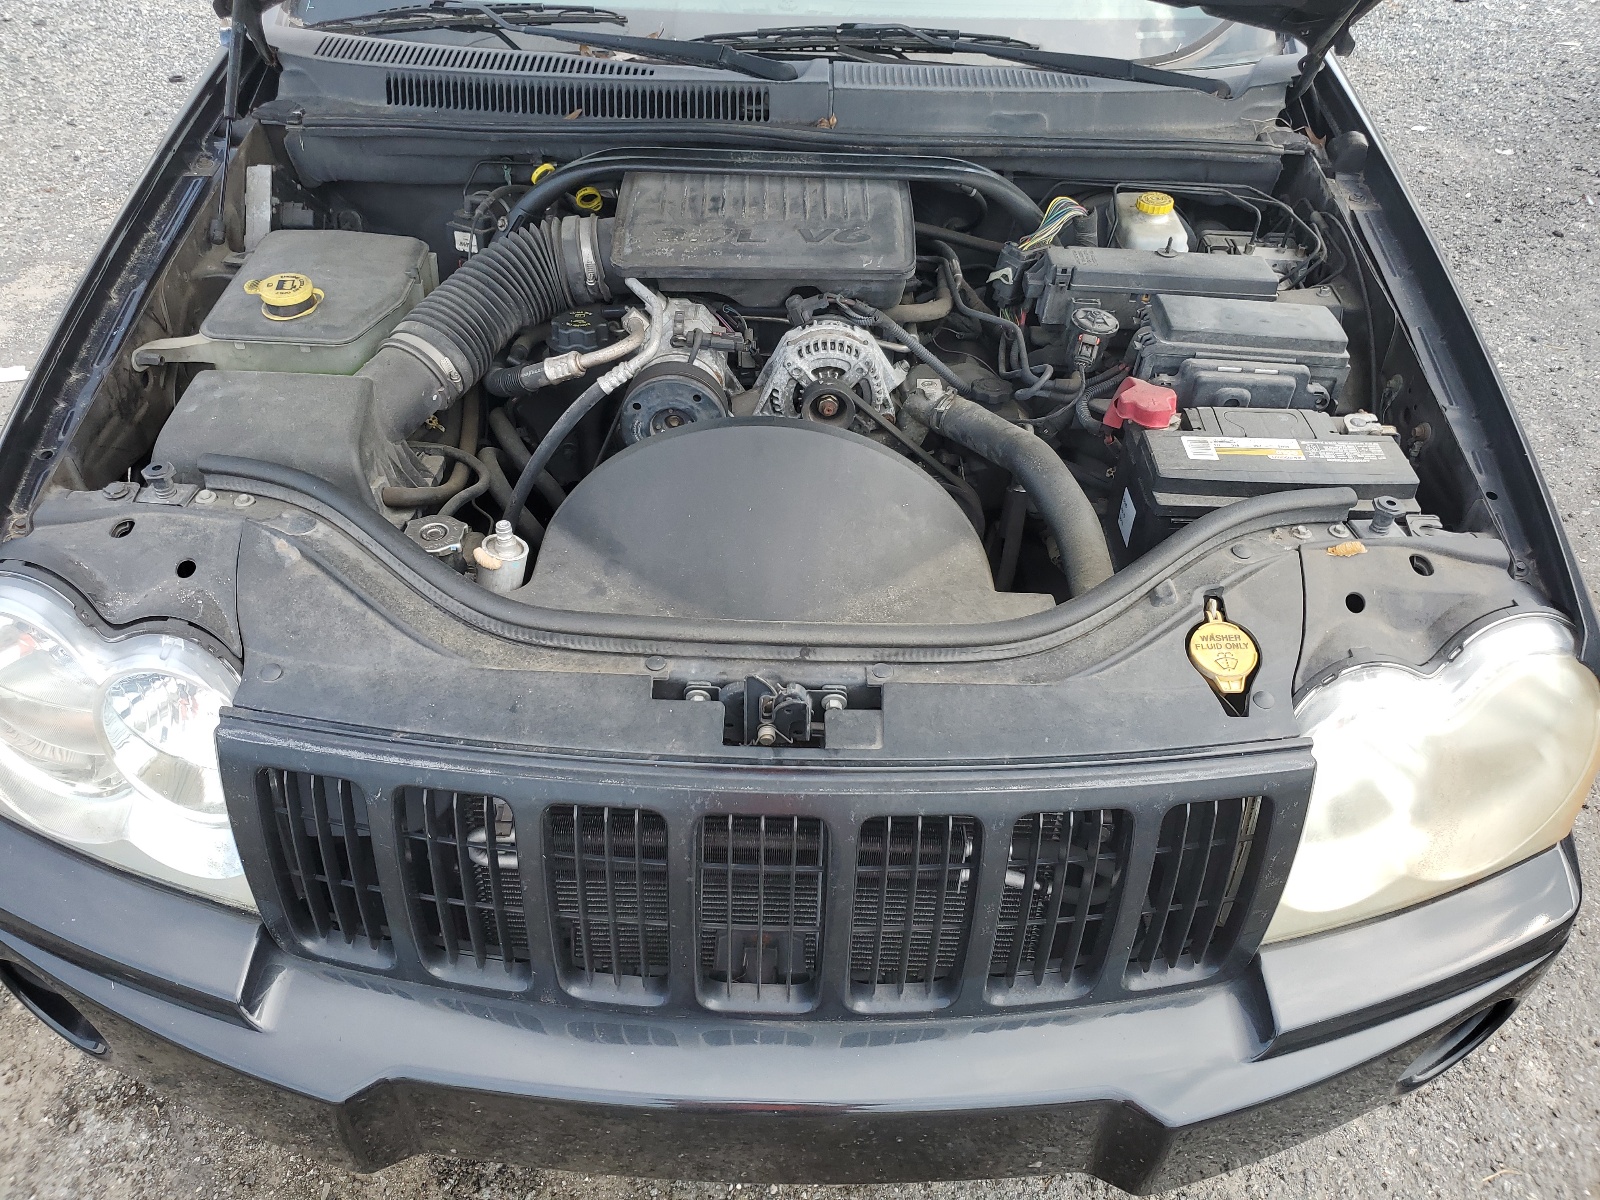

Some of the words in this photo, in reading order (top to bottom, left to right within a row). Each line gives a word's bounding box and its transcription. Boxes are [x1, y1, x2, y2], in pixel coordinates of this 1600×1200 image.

[797, 226, 872, 244] V6
[1199, 634, 1242, 642] WASHER
[1194, 642, 1223, 650] FLUID
[1224, 642, 1249, 650] ONLY
